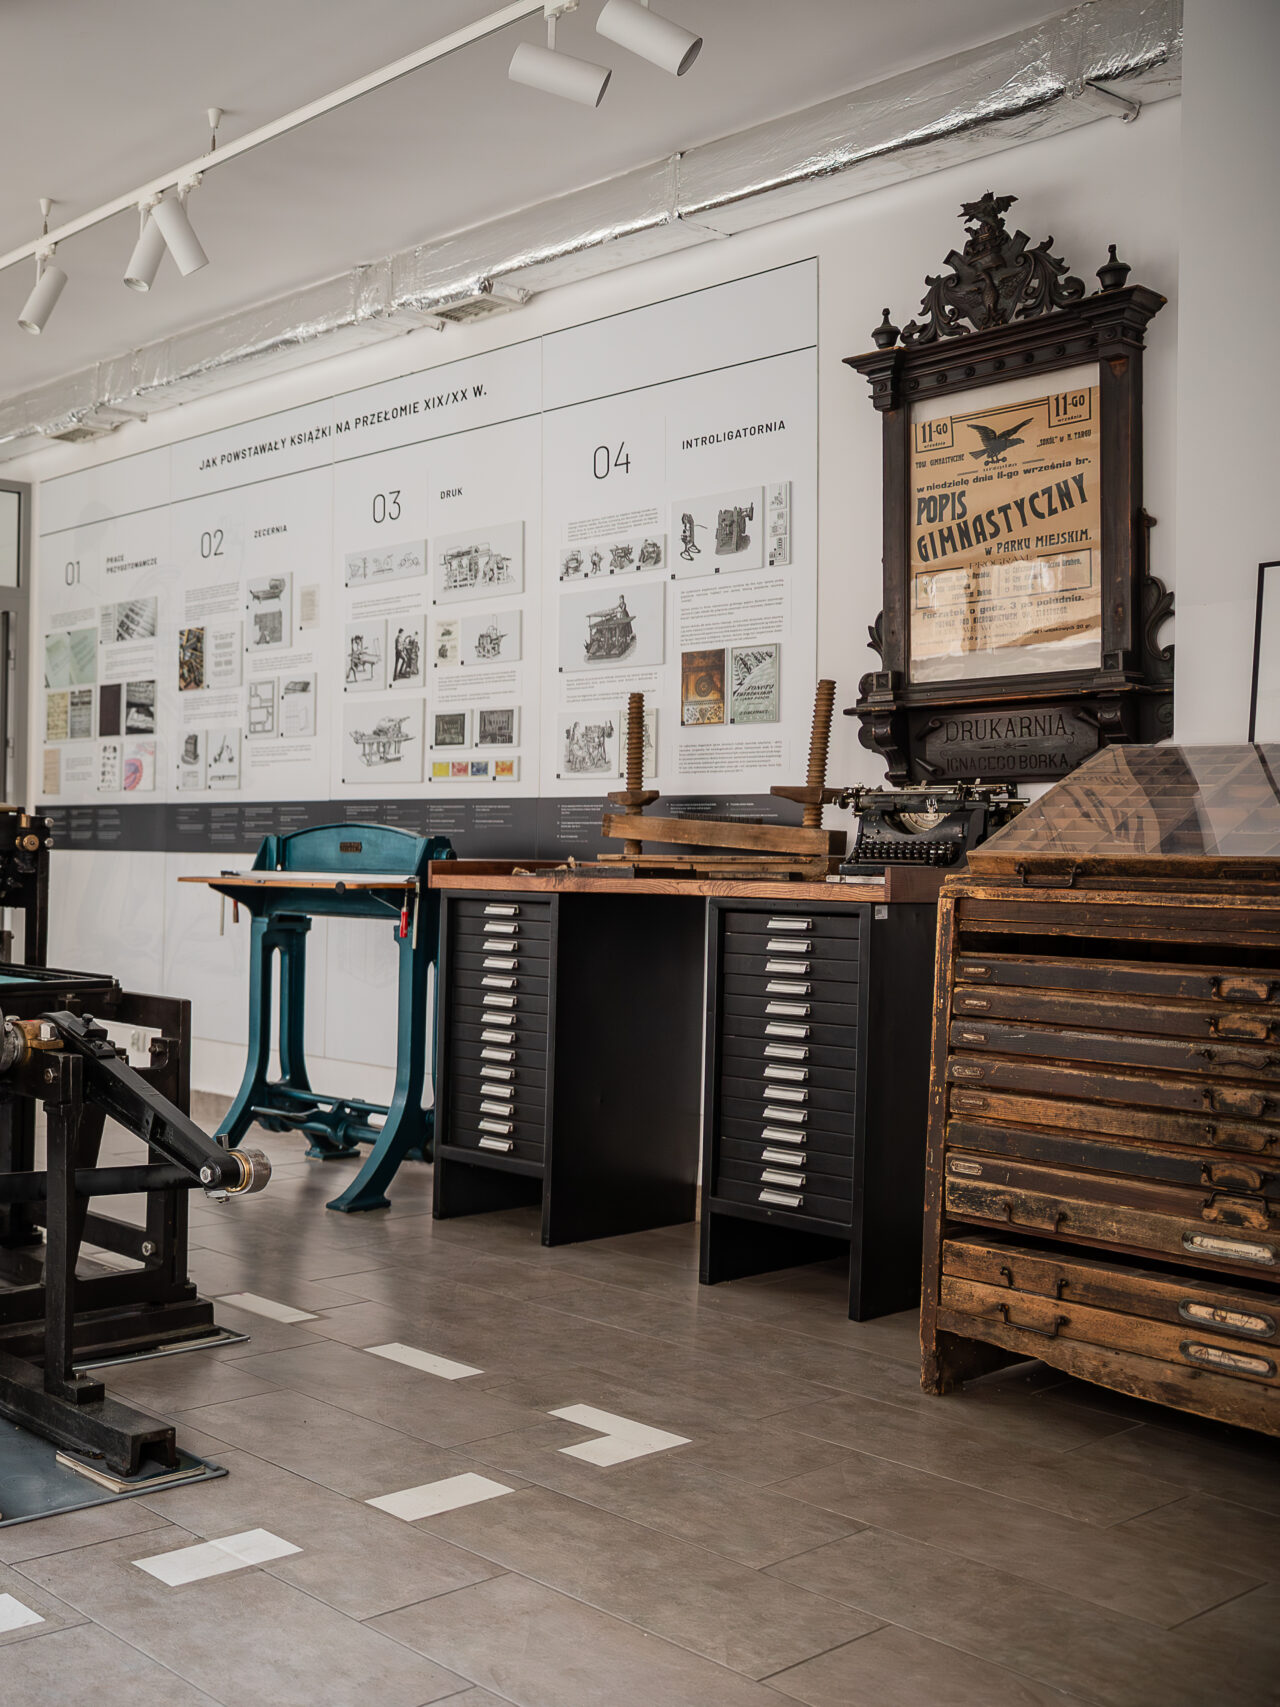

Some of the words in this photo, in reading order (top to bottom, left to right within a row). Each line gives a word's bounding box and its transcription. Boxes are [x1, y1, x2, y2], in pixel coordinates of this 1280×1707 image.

[1054, 393, 1086, 417] 11-GO
[199, 457, 218, 471] JAK
[220, 438, 287, 465] POWSTAWAŁY
[290, 425, 332, 446] KSIĄŻKI
[335, 420, 351, 434] NA
[354, 402, 420, 429] PRZEŁOMIE
[424, 388, 468, 411] XIX/XX
[472, 384, 488, 398] W.
[681, 420, 786, 450] INTROLIGATORNIA
[921, 421, 949, 444] 11-GO
[593, 441, 631, 479] 04
[926, 477, 970, 492] niedzielę
[972, 473, 994, 484] dnia
[1023, 460, 1072, 475] września
[1075, 457, 1092, 466] br.
[372, 490, 401, 523] 03
[440, 487, 463, 500] DRUK
[916, 490, 968, 526] POPIS
[253, 524, 288, 539] ZECERNIA
[917, 472, 1088, 563] GIMNASTYCZNY
[201, 529, 224, 558] 02
[996, 537, 1031, 553] PARKU
[1035, 528, 1092, 548] MIEJSKIM.
[65, 560, 80, 586] 01
[979, 605, 1006, 615] godz.
[1010, 602, 1017, 610] 3
